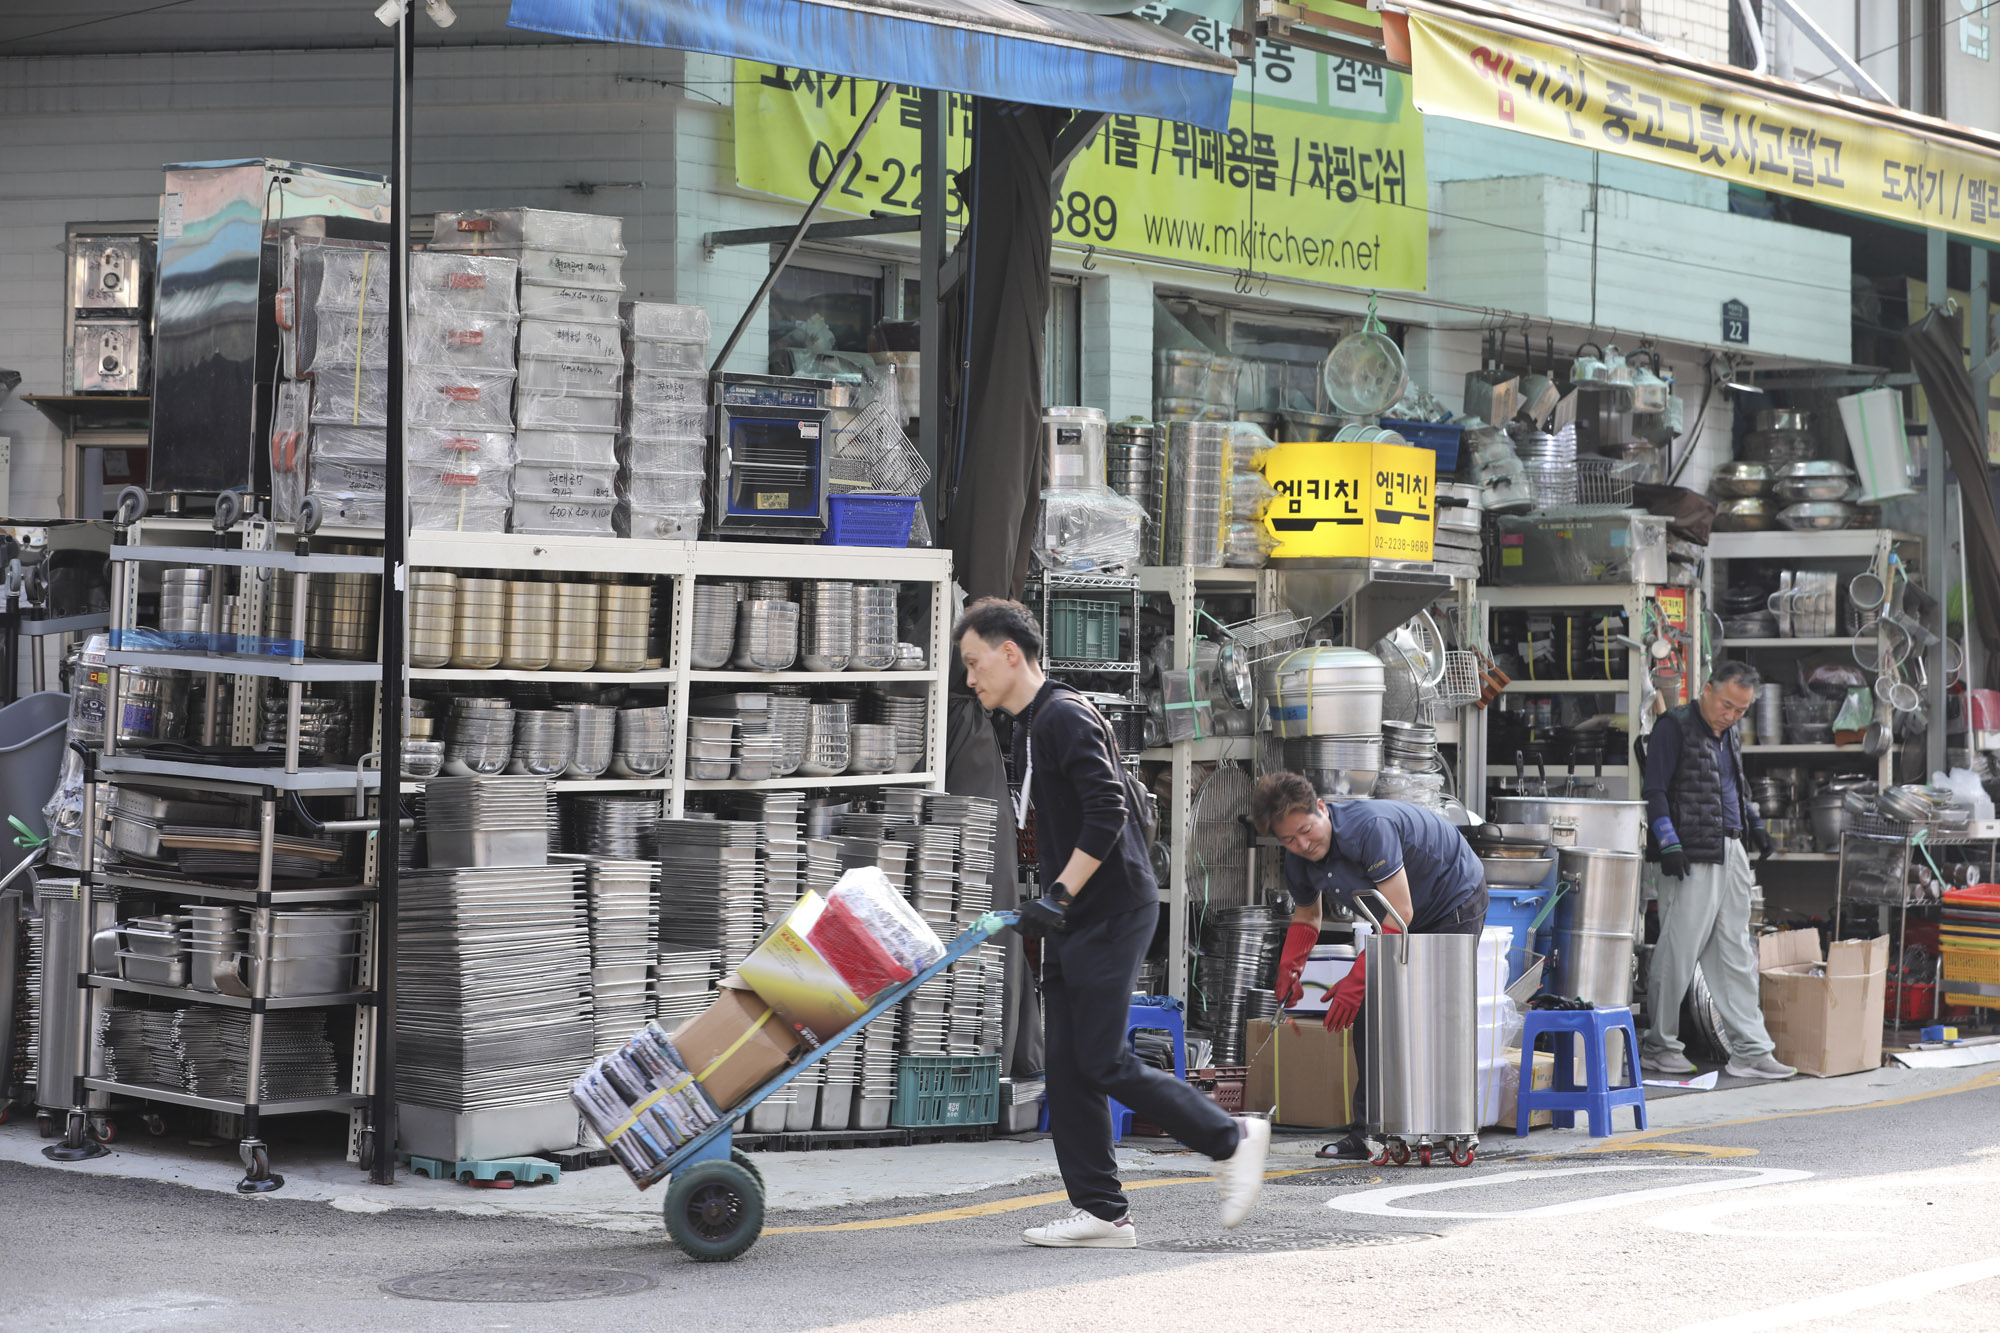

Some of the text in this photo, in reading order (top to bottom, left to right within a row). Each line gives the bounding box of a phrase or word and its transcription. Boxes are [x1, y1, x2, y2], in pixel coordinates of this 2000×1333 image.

[1333, 57, 1383, 97] 검색
[1470, 45, 1588, 141] 엠키친
[1602, 80, 1845, 189] 중고그릇사고팔고
[1882, 159, 1945, 215] 도자기
[1308, 141, 1406, 206] 챠핑디쉬
[1144, 213, 1381, 271] www.mkitchen.net
[1729, 321, 1742, 340] 22
[1273, 479, 1359, 514] 엠키친
[1377, 471, 1428, 510] 엠키친
[1374, 535, 1430, 553] 02-2238-9689
